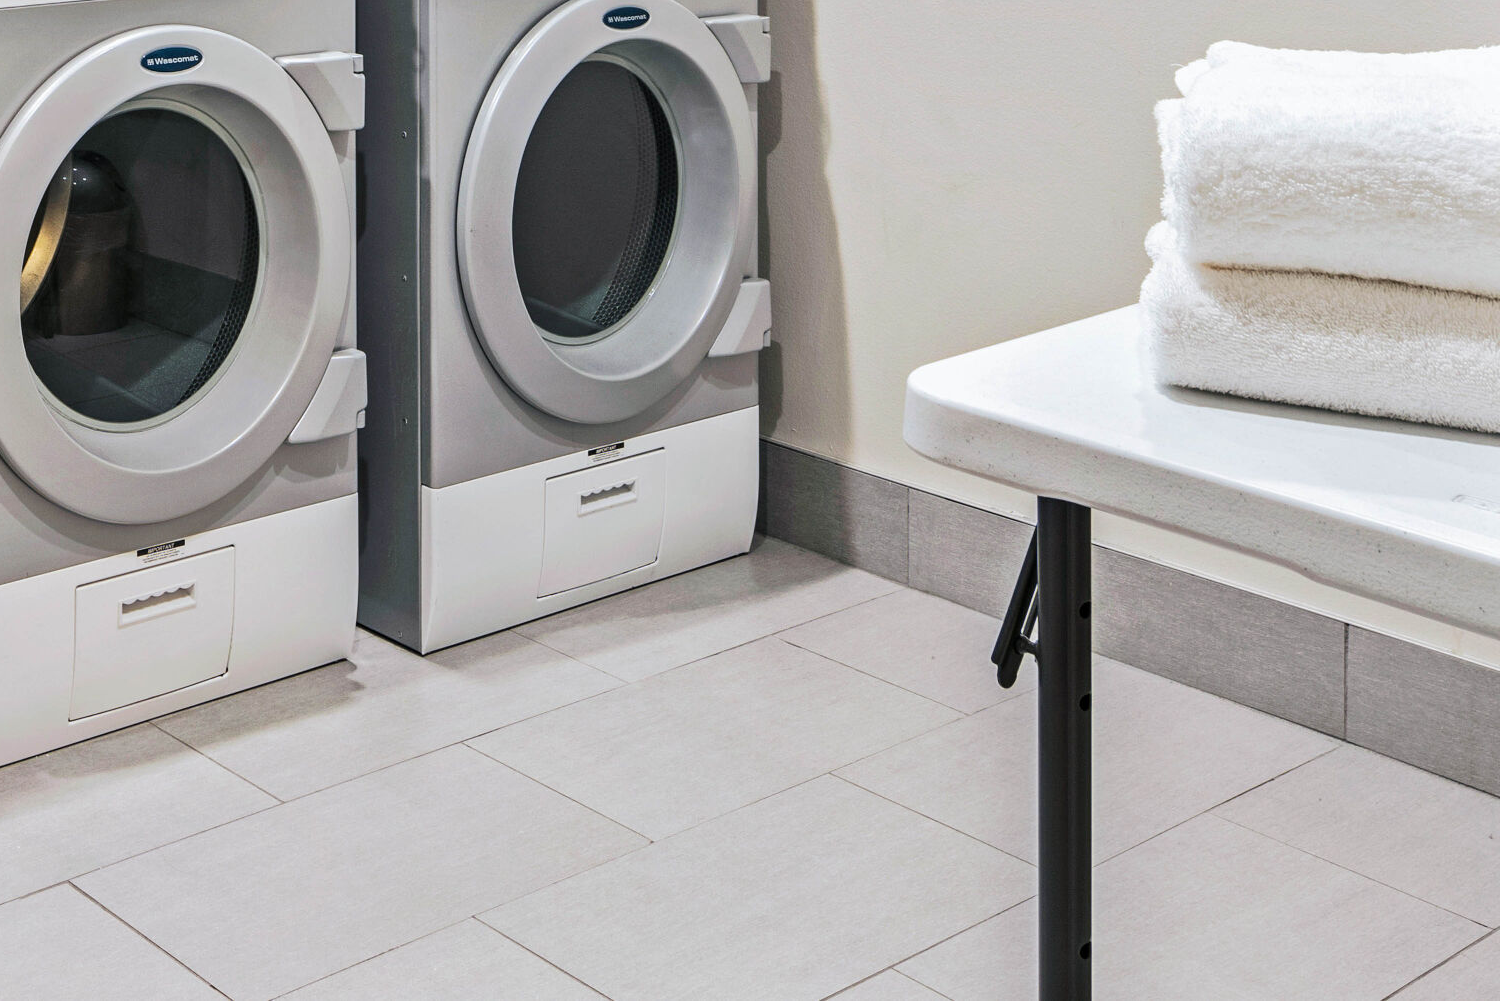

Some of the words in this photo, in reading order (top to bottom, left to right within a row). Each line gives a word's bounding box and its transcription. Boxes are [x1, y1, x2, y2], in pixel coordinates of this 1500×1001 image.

[614, 14, 646, 22] Wascomat
[154, 55, 199, 65] Wascomat
[148, 542, 175, 554] IMPORTANT
